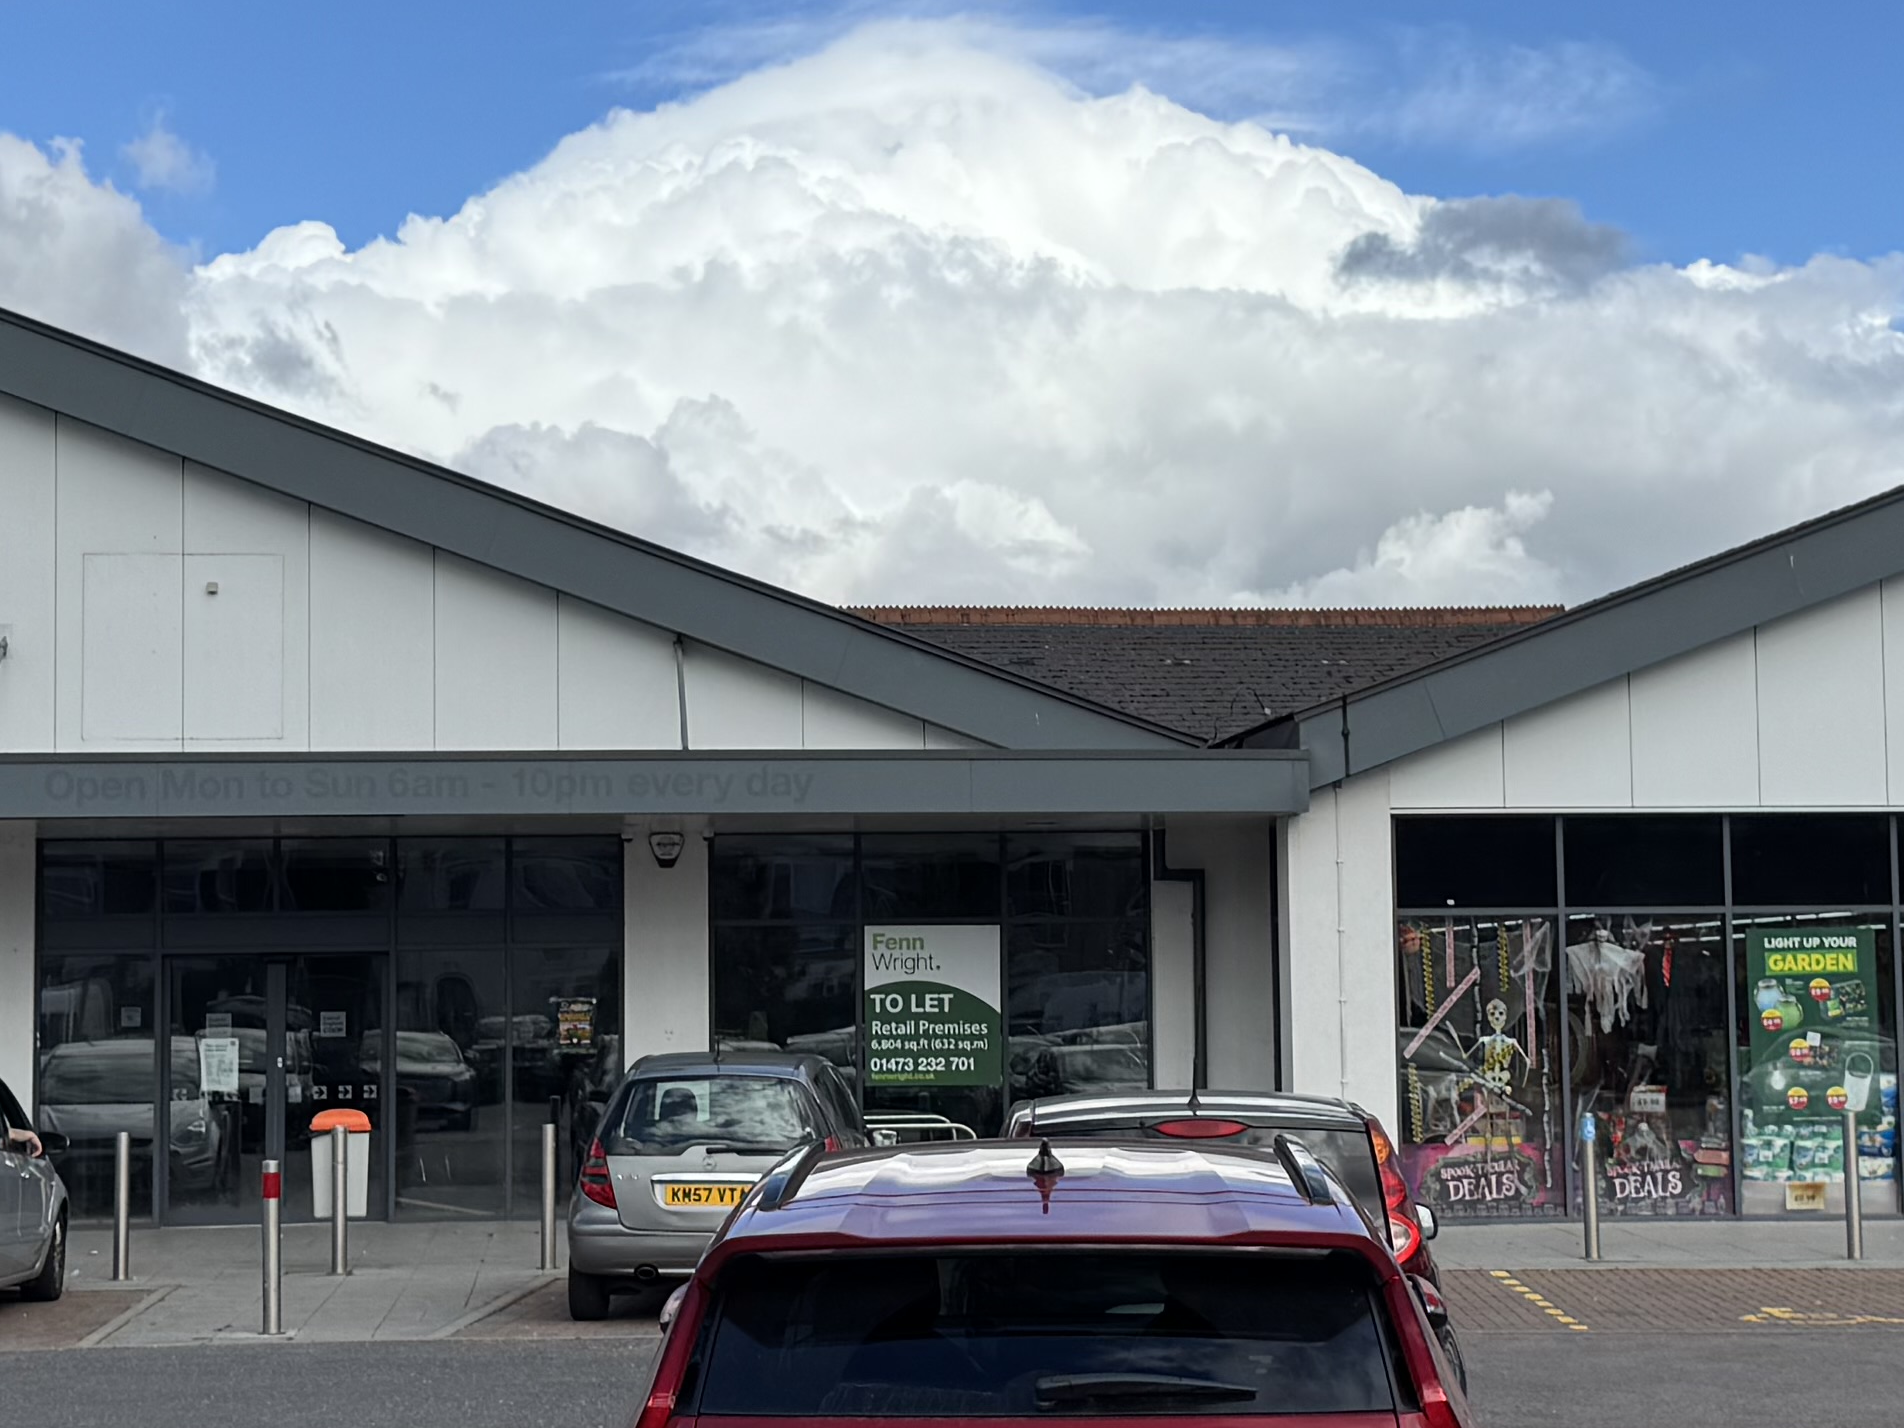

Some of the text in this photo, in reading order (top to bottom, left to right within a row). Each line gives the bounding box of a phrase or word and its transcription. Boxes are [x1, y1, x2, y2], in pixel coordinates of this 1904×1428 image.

[46, 771, 146, 805] Open
[161, 769, 244, 800] Mon
[257, 771, 295, 800] to
[306, 769, 378, 800] Sun
[388, 768, 469, 798] 6am
[515, 767, 610, 808] 10pm
[627, 771, 730, 806] every
[746, 765, 814, 801] day
[872, 933, 925, 951] Fenn
[1764, 936, 1857, 949] LIGHT UP YOUR
[872, 952, 941, 975] Wright.
[1769, 952, 1855, 972] GARDEN
[870, 994, 954, 1013] TO LET
[872, 1021, 988, 1035] Retail Premises
[871, 1038, 988, 1051] 6,804 sq.ft (632 sq.m)
[870, 1057, 975, 1071] 01473 232 701
[1446, 1173, 1515, 1201] DEALS
[1613, 1171, 1683, 1198] DEALS
[672, 1187, 713, 1202] KM57
